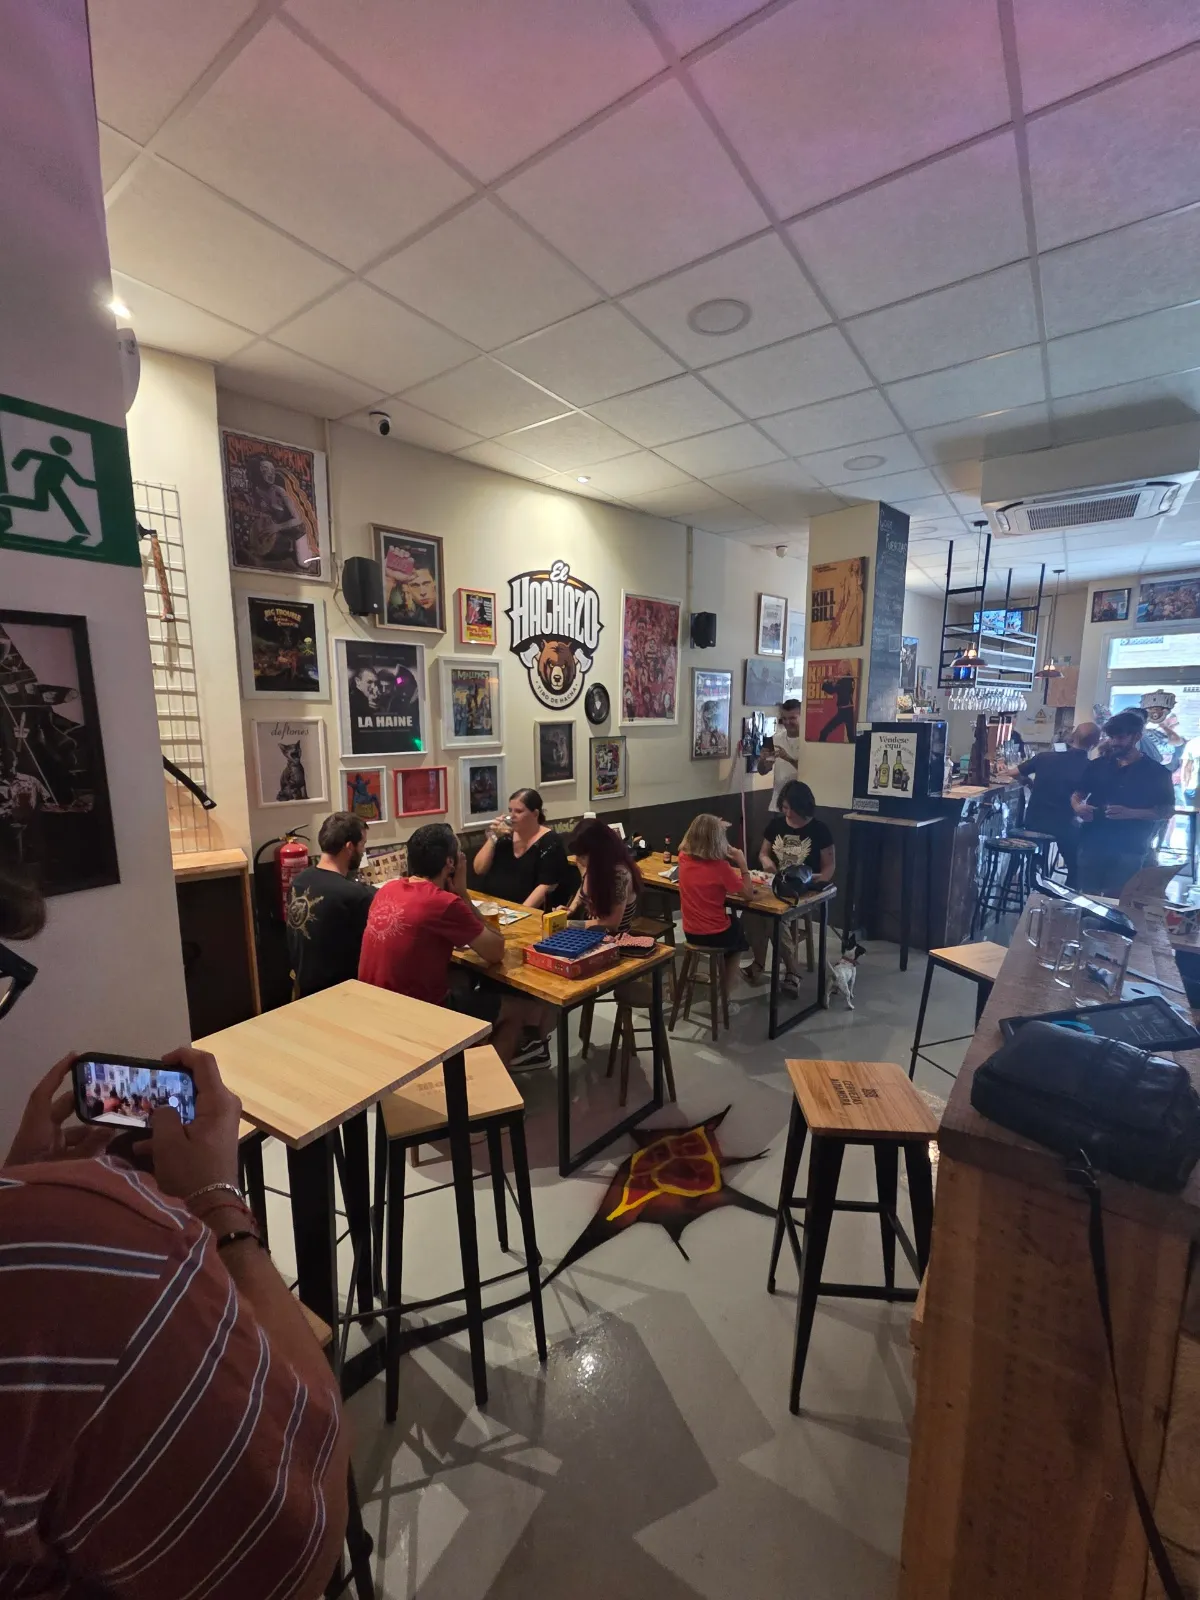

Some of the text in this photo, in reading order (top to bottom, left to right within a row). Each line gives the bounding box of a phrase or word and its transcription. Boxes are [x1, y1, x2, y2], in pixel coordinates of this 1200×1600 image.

[550, 562, 569, 581] El
[811, 587, 836, 609] KILL
[508, 576, 600, 649] HACHAZO
[811, 604, 836, 623] BILL
[537, 685, 549, 700] TIRO
[560, 687, 577, 704] HACHA
[270, 721, 309, 740] deftones
[357, 716, 413, 728] LA HAINE
[830, 1078, 852, 1106] ALHAMBRA
[842, 1080, 863, 1105] CERVEZAS
